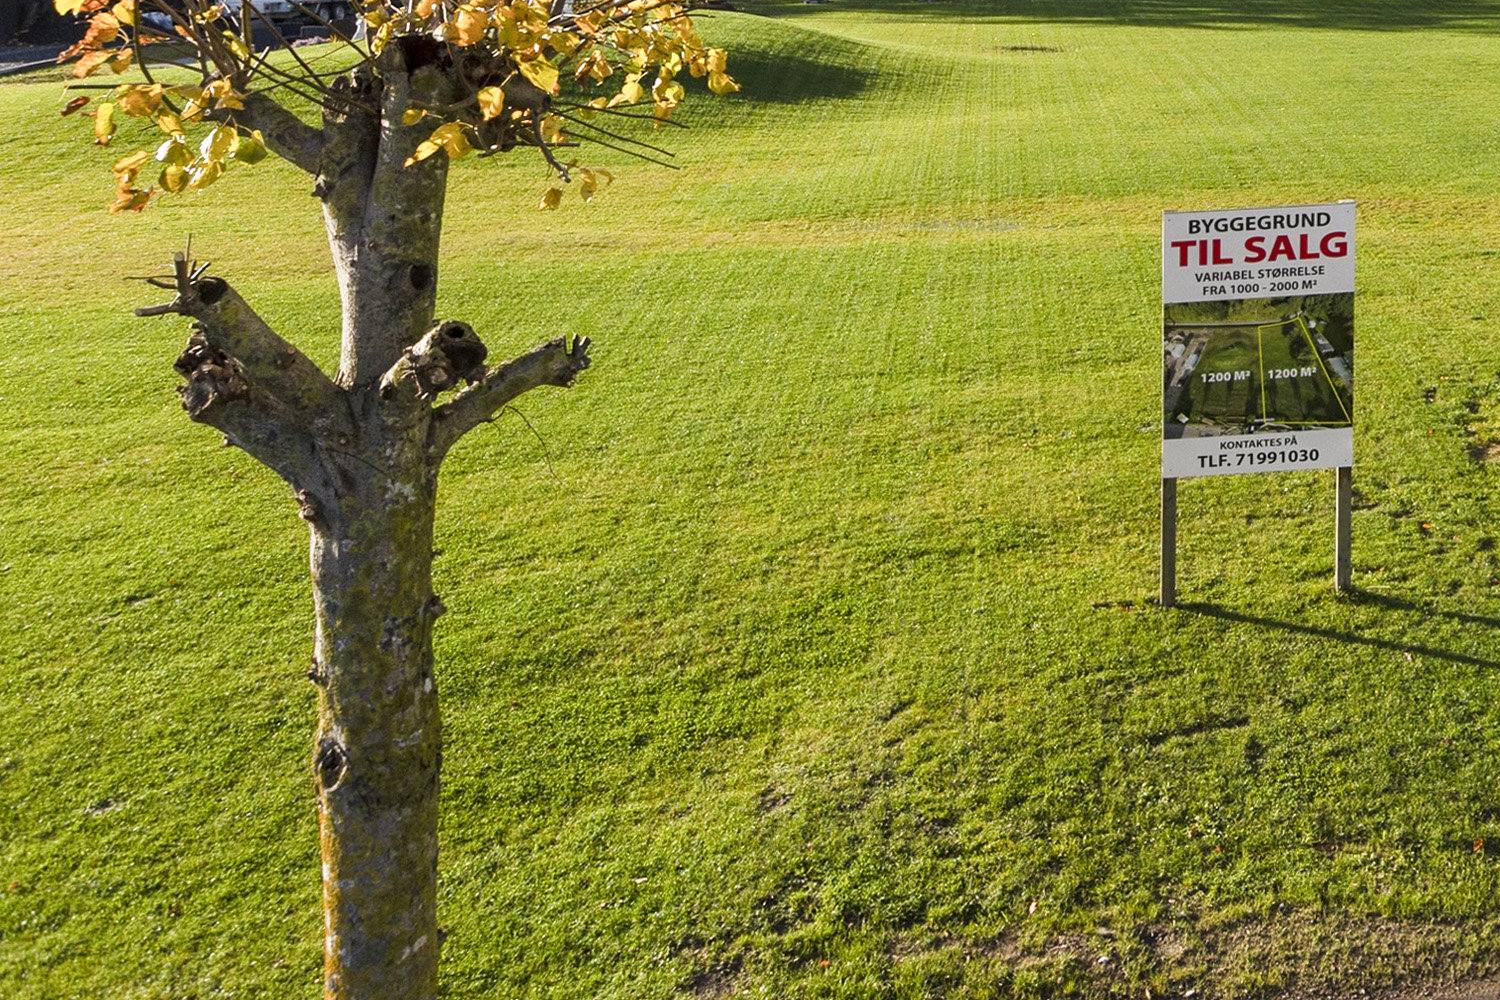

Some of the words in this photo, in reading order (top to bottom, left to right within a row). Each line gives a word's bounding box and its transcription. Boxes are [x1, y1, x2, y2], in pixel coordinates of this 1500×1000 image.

[1188, 212, 1331, 234] BYGGEGRUND
[1171, 239, 1233, 267] TIL
[1244, 231, 1348, 263] SALG
[1195, 270, 1255, 283] VARIABEL
[1258, 265, 1325, 279] STØRRELSE
[1203, 285, 1227, 296] FRA
[1230, 283, 1260, 294] 1000
[1269, 280, 1299, 292] 2000
[1201, 372, 1231, 383] 1200
[1268, 368, 1298, 379] 1200
[1220, 437, 1282, 450] KONTAKTES
[1284, 434, 1298, 446] PÅ
[1197, 454, 1231, 468] TLF.
[1236, 448, 1320, 466] 71991030
